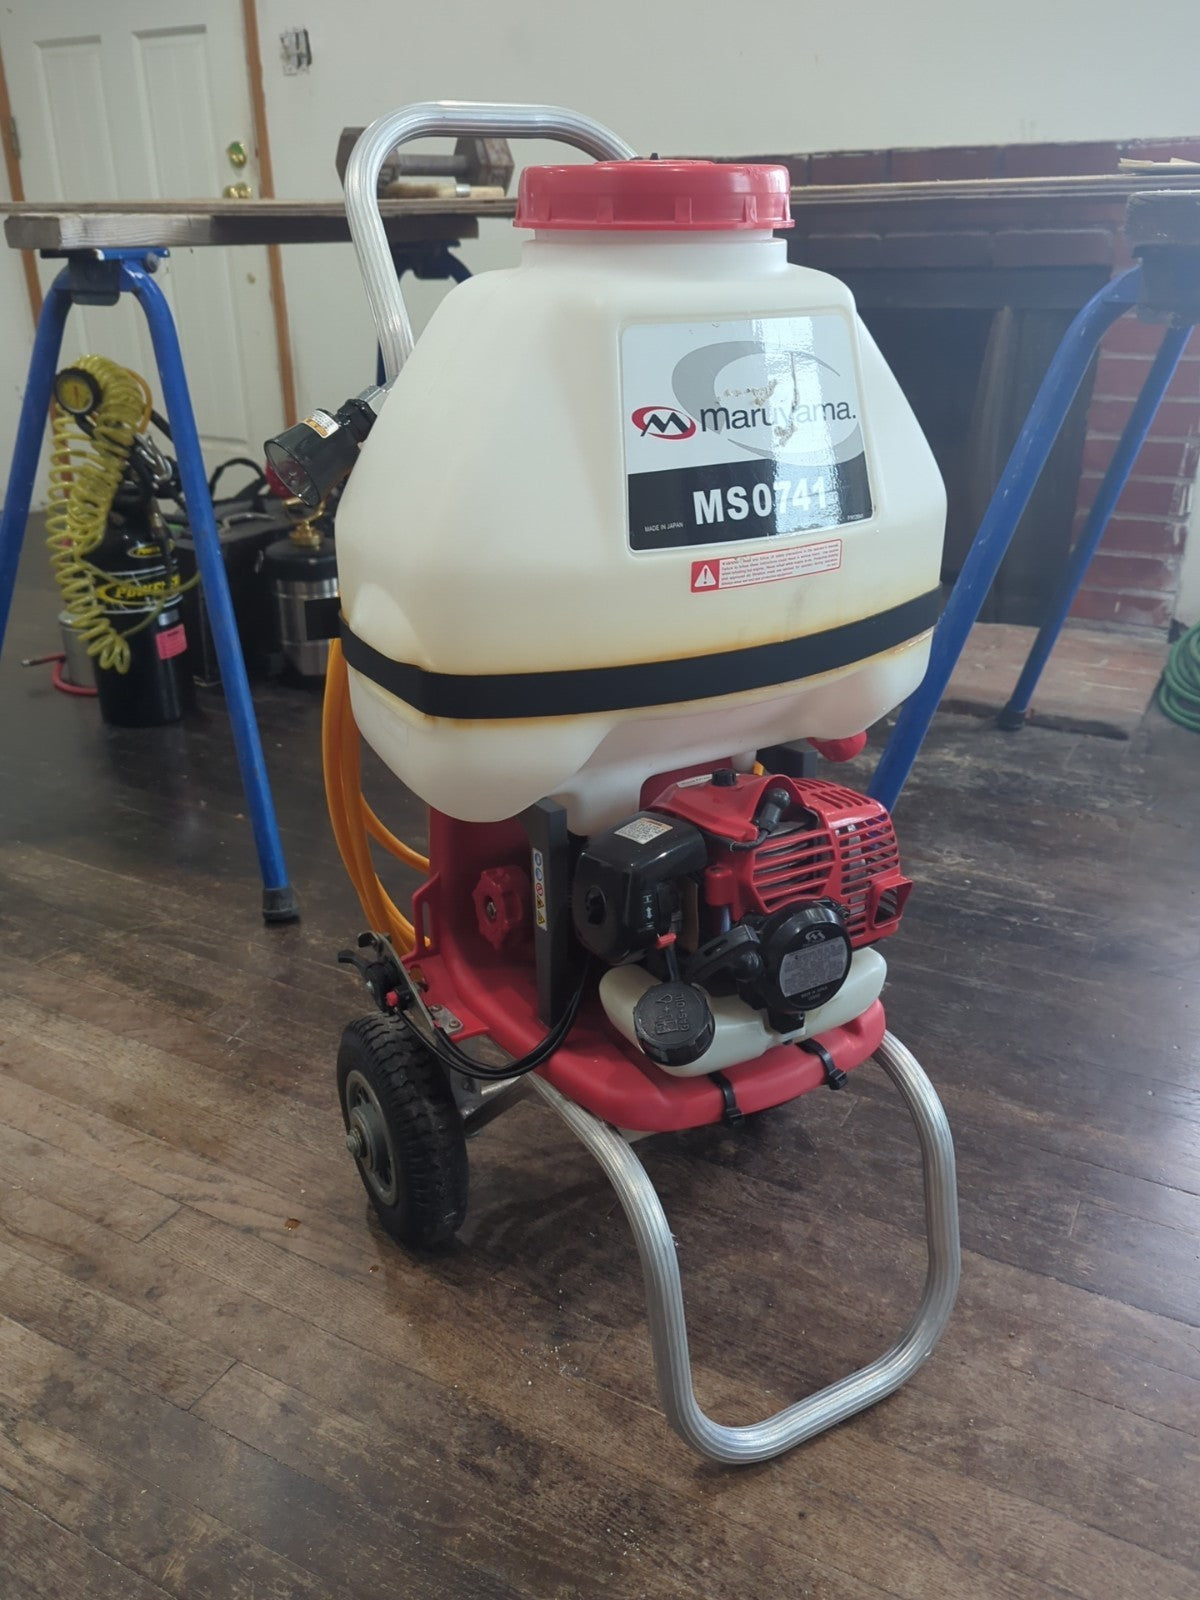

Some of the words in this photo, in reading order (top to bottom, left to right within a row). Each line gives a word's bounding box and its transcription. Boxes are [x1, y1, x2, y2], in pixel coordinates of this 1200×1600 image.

[692, 475, 828, 526] MS0741
[644, 524, 660, 532] MADE
[667, 521, 684, 530] JAPAN
